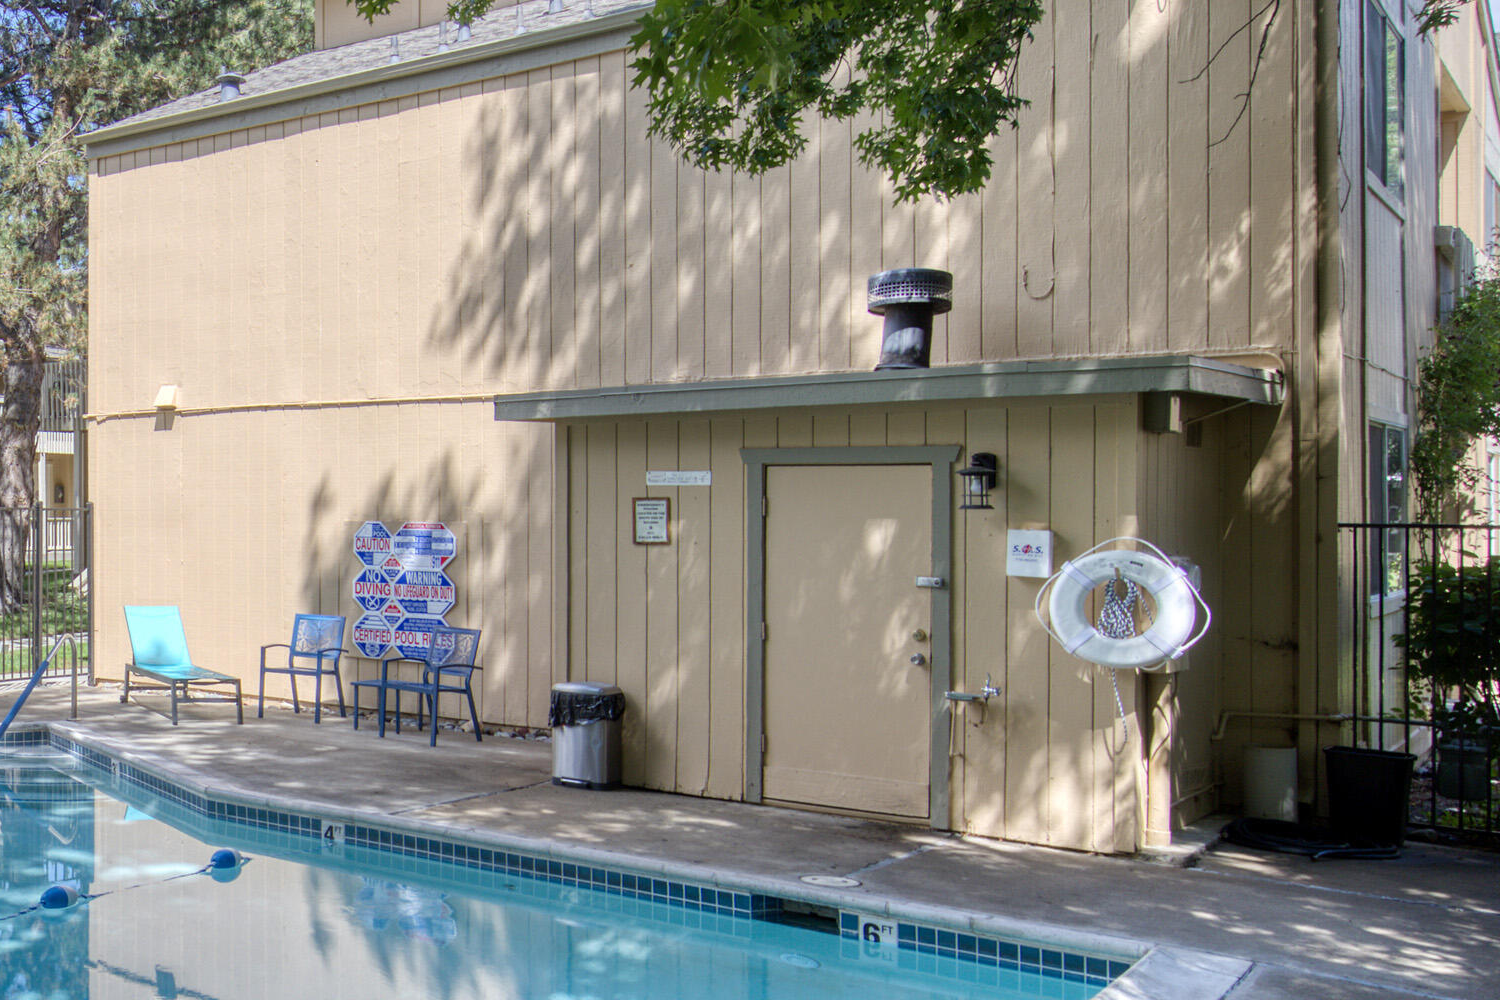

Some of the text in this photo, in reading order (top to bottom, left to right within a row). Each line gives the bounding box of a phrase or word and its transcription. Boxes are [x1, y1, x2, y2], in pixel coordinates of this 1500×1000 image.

[355, 538, 390, 551] CAUTION
[432, 556, 441, 569] 911
[366, 569, 381, 583] NO
[405, 571, 442, 585] WARNING
[355, 582, 391, 596] DIVING
[394, 584, 453, 600] NO LIFEGUARD ON DUTY
[354, 629, 391, 643] CERTIFIED
[395, 631, 420, 645] POOL
[324, 825, 334, 840] 4
[863, 922, 893, 943] 6 FT
